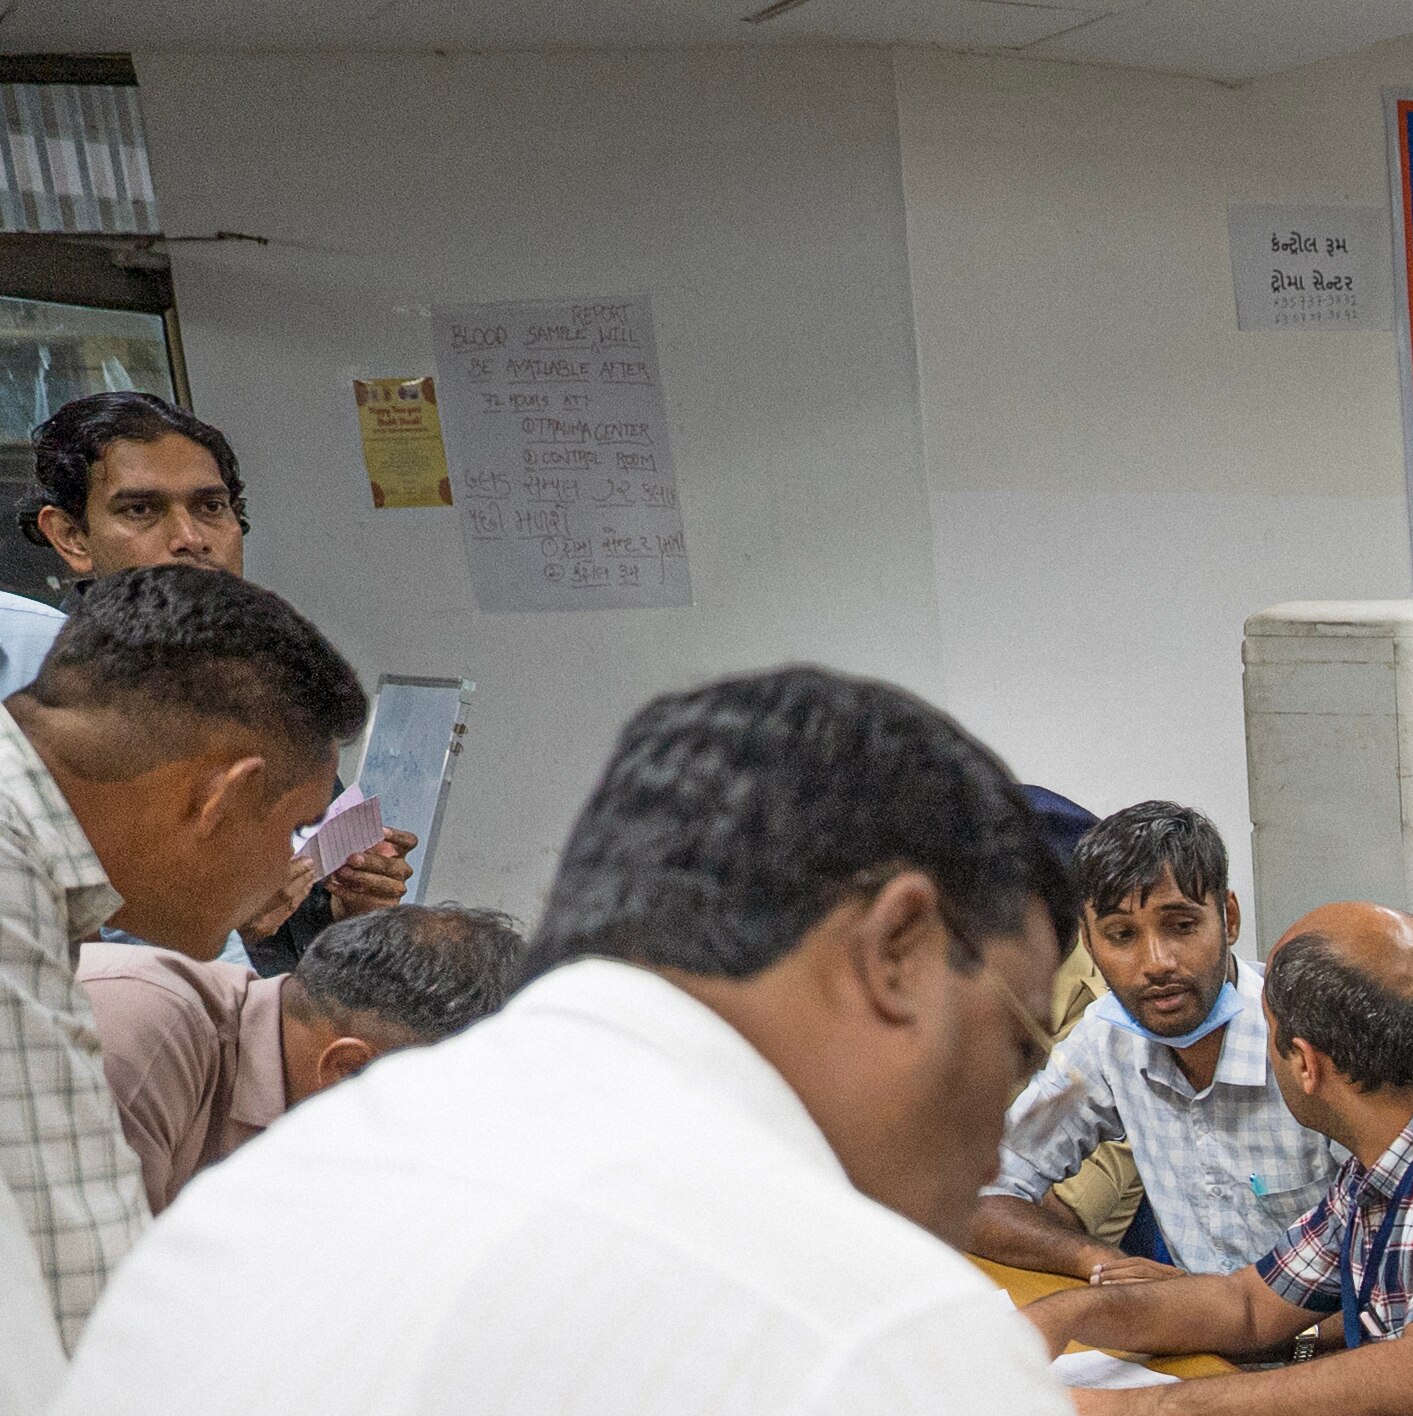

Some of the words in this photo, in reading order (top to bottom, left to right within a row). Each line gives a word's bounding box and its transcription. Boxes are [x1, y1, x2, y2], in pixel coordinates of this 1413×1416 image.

[1325, 237, 1349, 257] રૂમ
[1270, 269, 1305, 293] ટ્રોમા
[1312, 269, 1353, 291] સેન્ટર
[451, 324, 509, 348] BLOOD
[524, 325, 588, 347] SAMPLE
[598, 325, 639, 346] WILL
[599, 359, 652, 381] AFTER
[594, 421, 653, 443] CENTER
